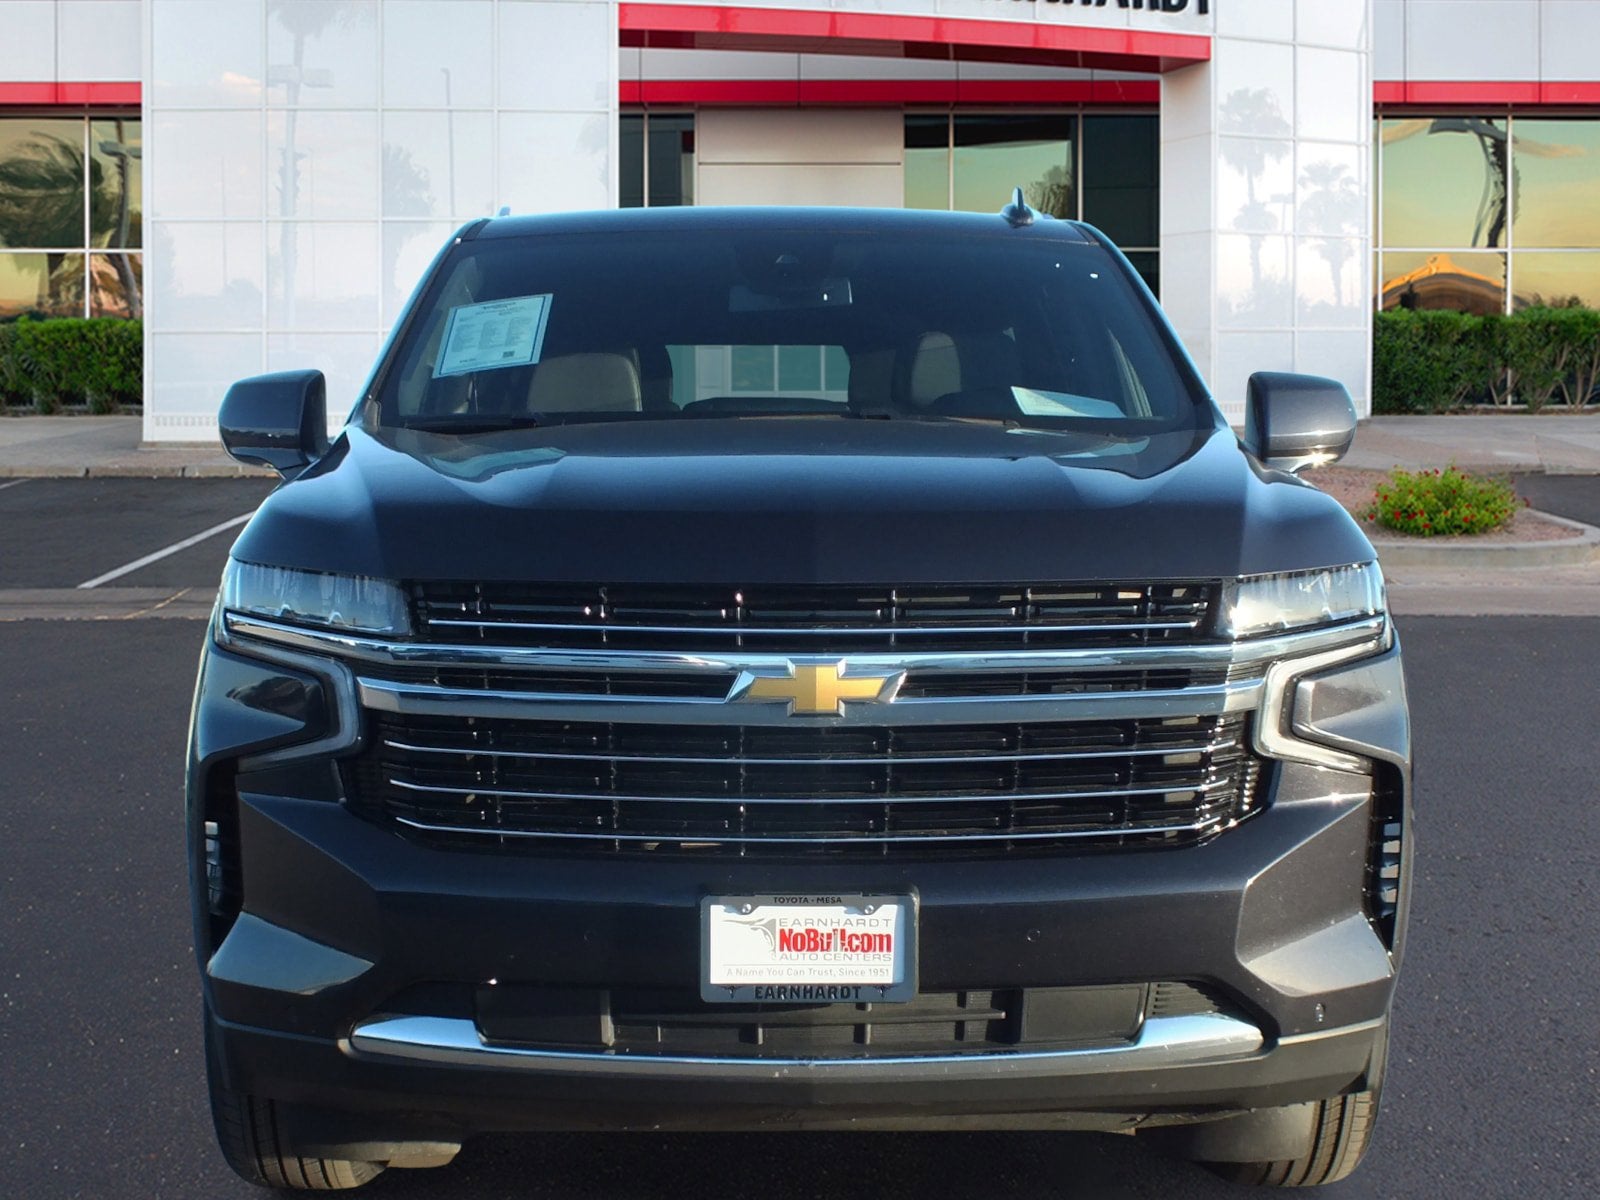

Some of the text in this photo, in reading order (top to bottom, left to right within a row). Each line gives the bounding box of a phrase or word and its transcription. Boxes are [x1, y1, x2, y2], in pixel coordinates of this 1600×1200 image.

[773, 896, 842, 904] TOYOTA MESA
[779, 918, 892, 928] EARNHARDT
[779, 953, 892, 962] AUTO CENTERS
[726, 967, 889, 979] A Name You Can Trust, Since 1951
[754, 985, 862, 1000] EARNHARDT
